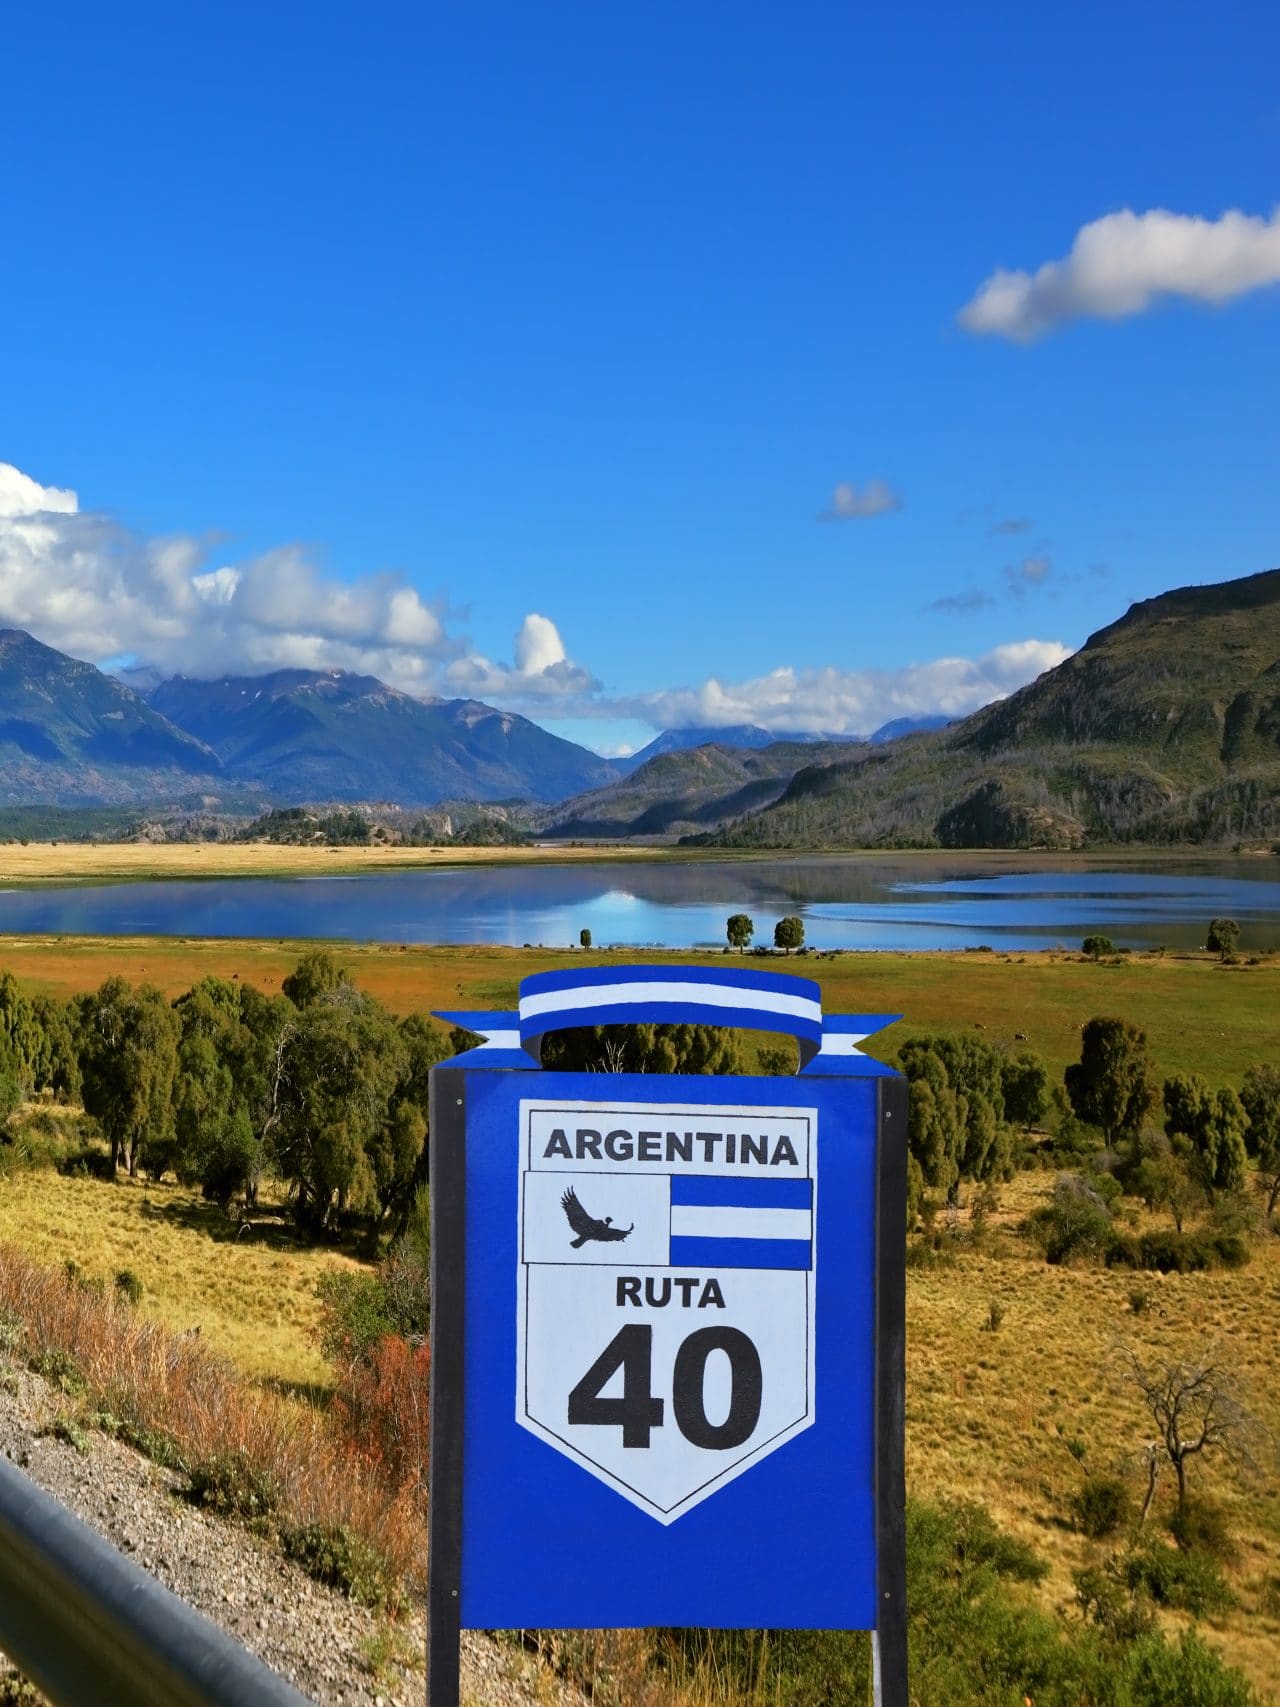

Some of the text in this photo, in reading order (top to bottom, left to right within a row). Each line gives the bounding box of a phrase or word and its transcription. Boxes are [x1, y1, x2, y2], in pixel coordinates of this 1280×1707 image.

[543, 1129, 799, 1165] ARGENTINA
[617, 1277, 726, 1308] RUTA
[568, 1324, 763, 1450] 40
